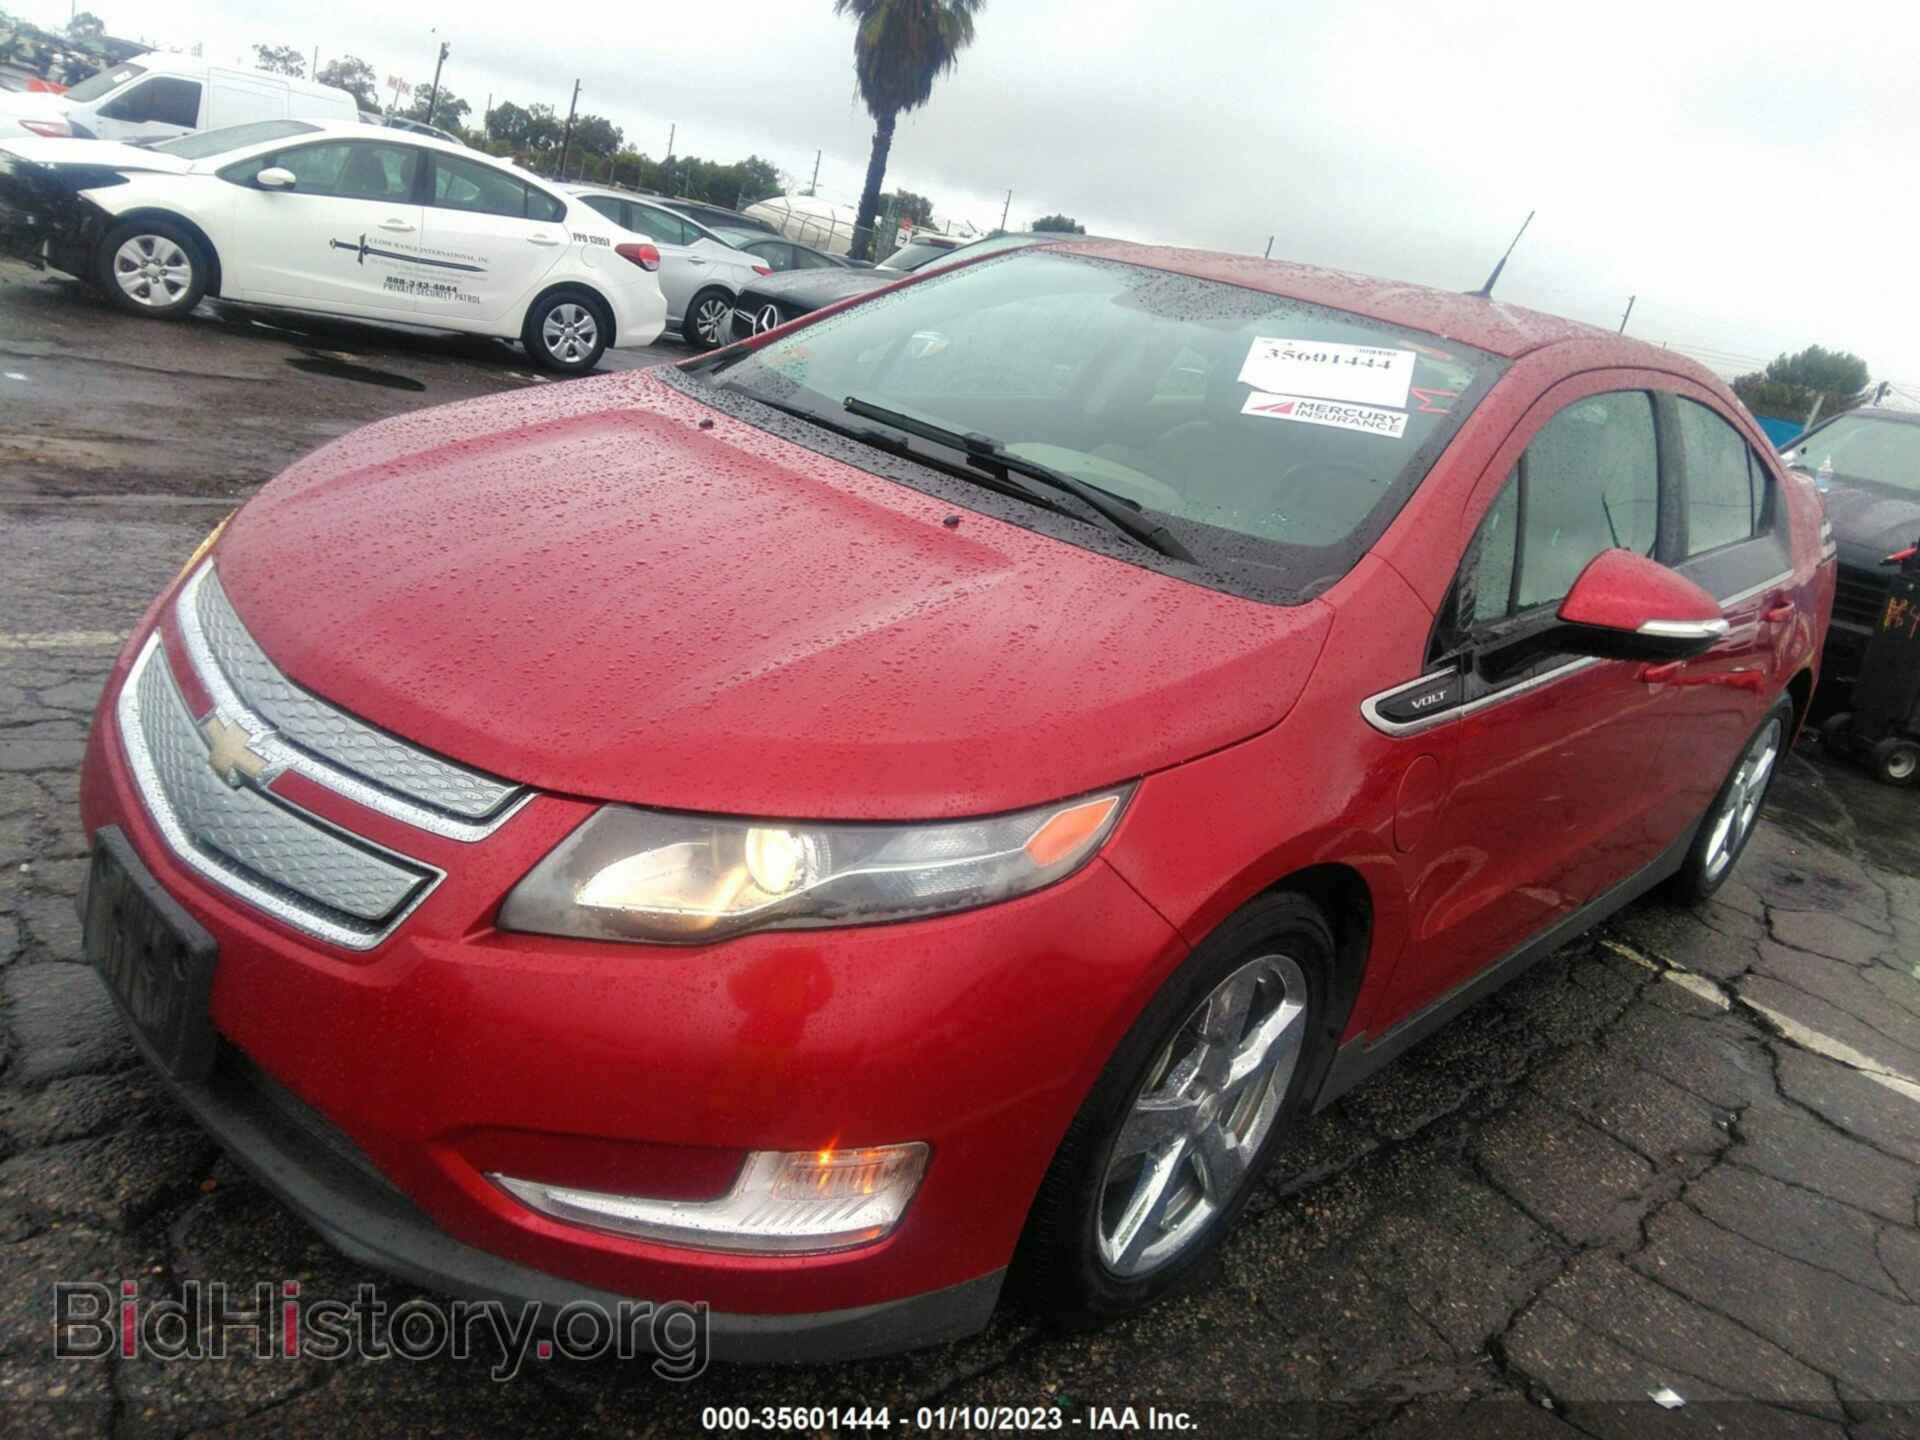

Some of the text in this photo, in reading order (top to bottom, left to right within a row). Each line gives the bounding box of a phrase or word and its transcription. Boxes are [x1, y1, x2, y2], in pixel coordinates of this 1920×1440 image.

[383, 281, 481, 305] PRIVATE SECURITY PATROL
[1264, 347, 1392, 370] 35601444
[1294, 409, 1401, 434] INSURANCE
[1297, 400, 1402, 425] MERCURY
[1411, 689, 1448, 709] VOLT
